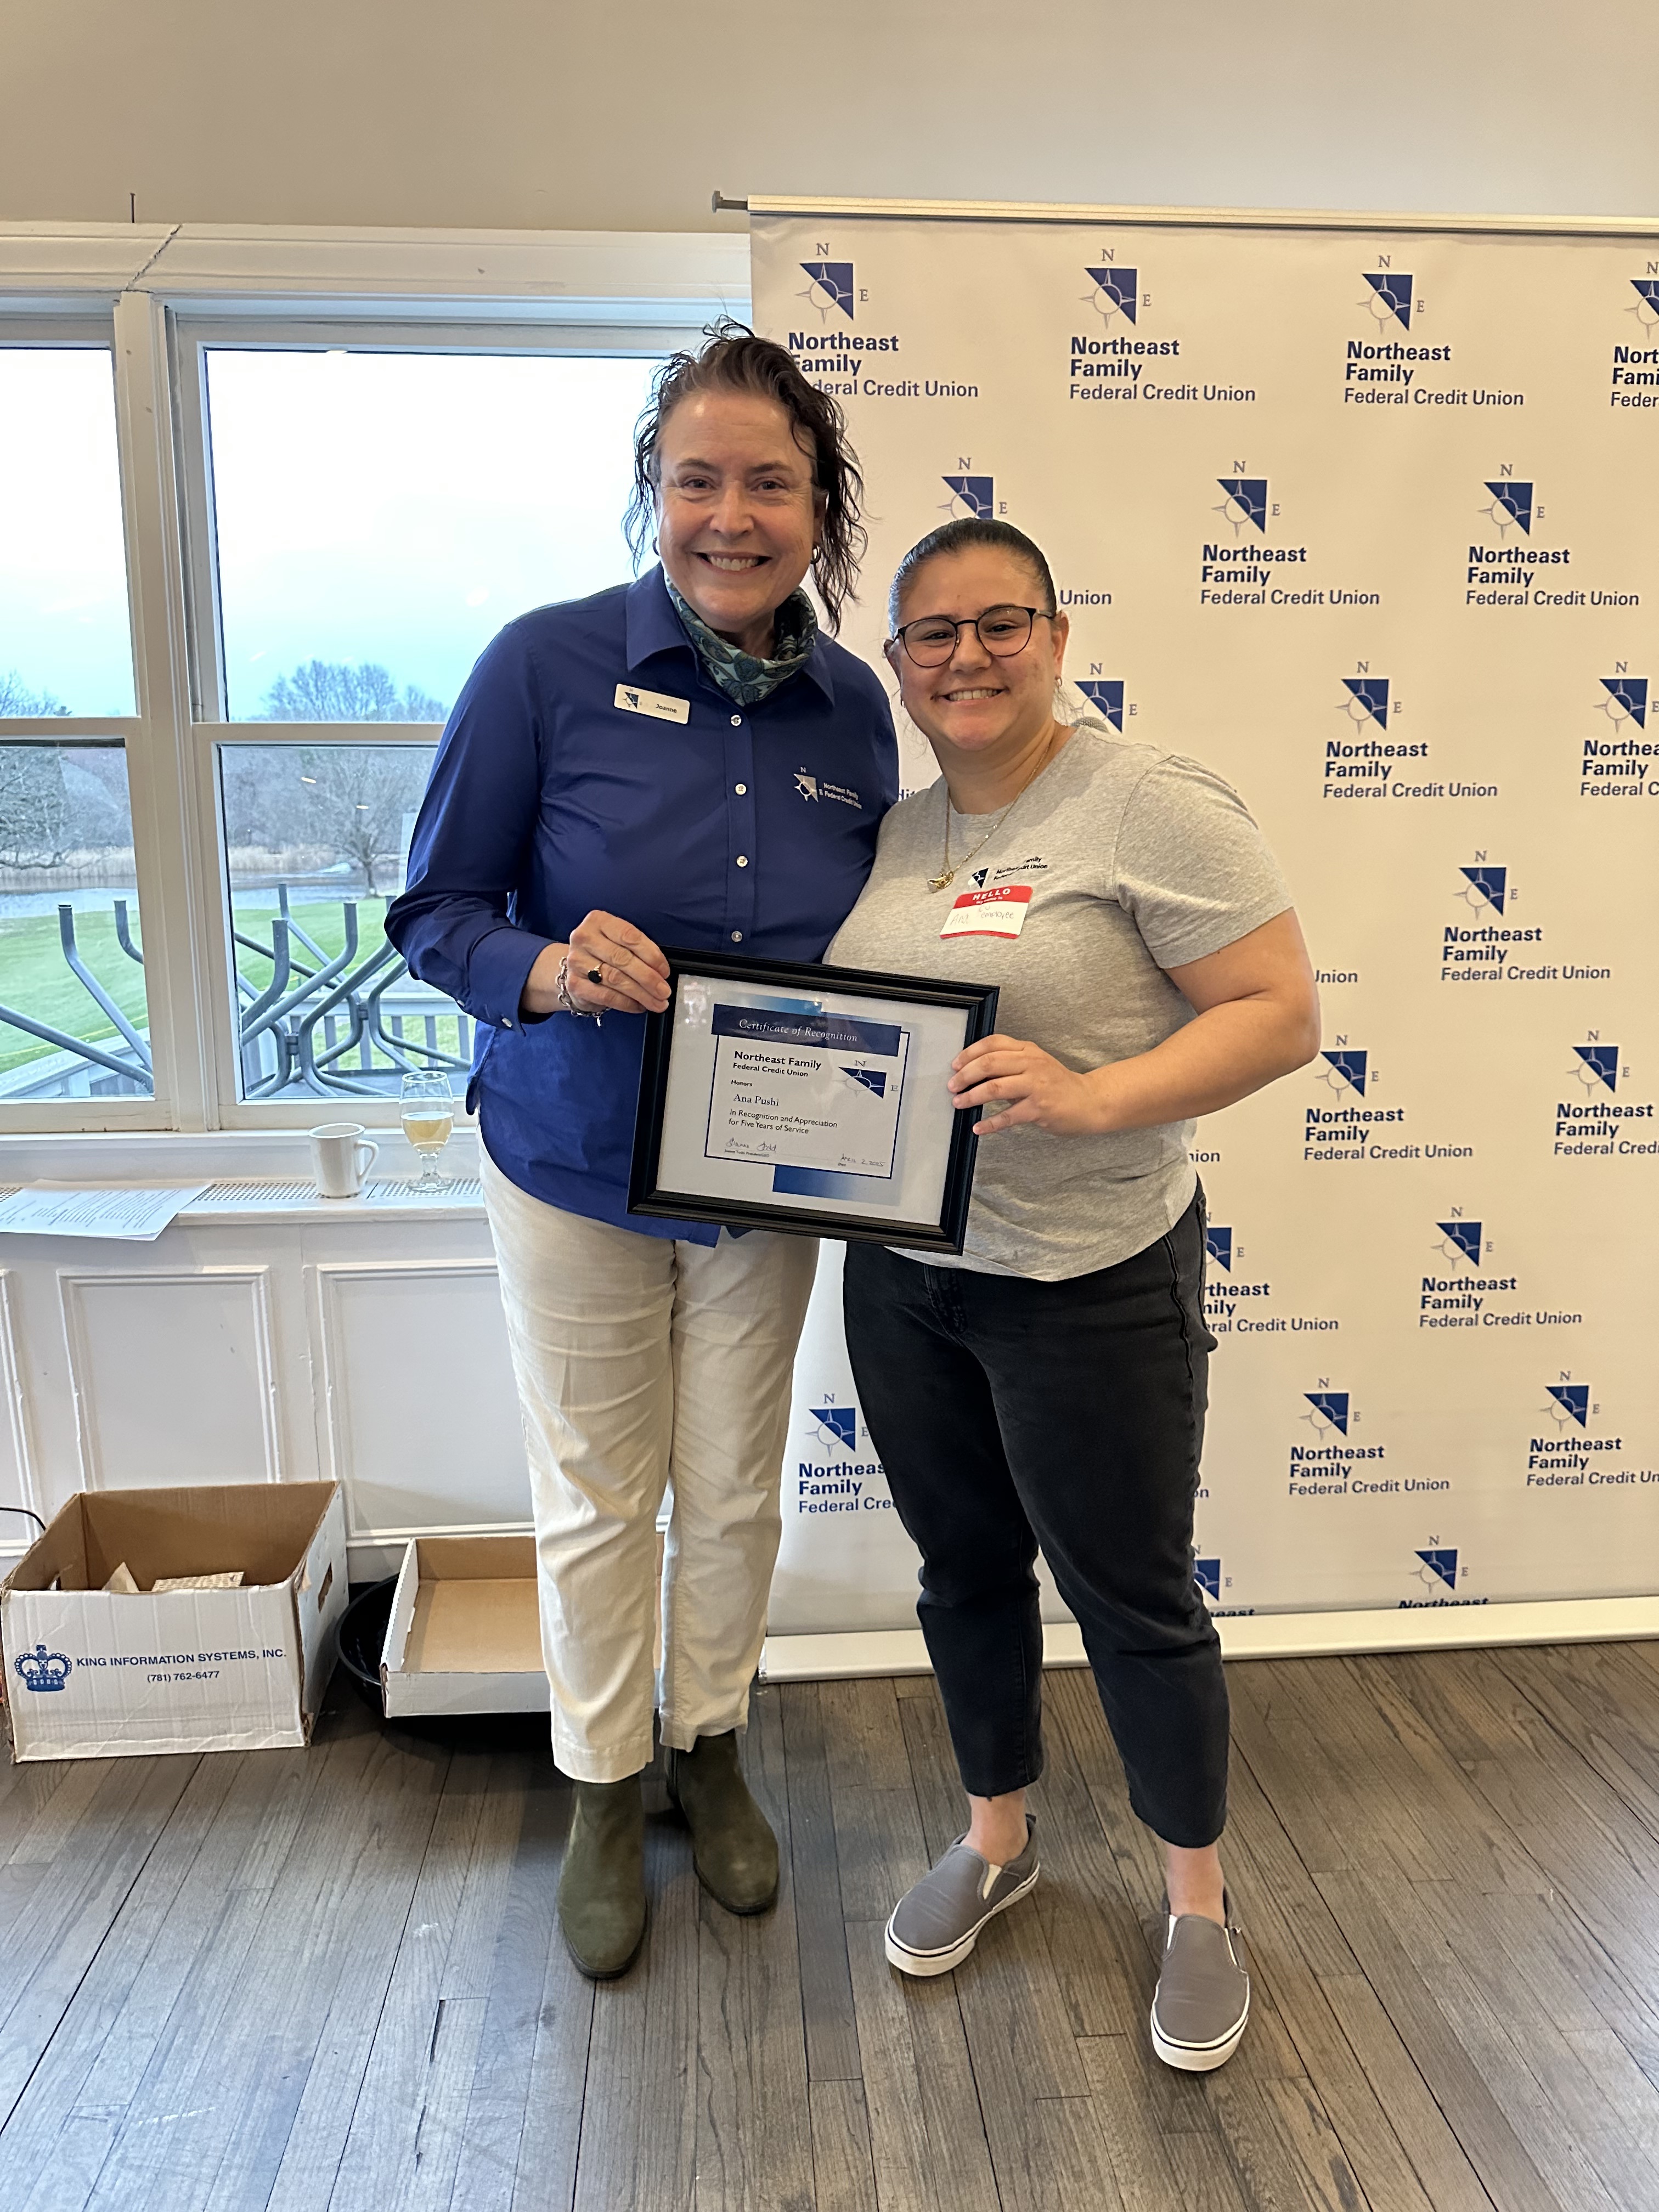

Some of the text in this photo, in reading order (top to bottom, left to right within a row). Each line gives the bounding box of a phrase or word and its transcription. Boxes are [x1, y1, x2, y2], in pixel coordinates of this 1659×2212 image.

[816, 243, 830, 256] N
[1102, 249, 1114, 261] N
[1378, 256, 1391, 268] N
[859, 289, 868, 301] E
[1143, 294, 1152, 306] E
[1417, 300, 1424, 313] E
[788, 332, 899, 352] Northeast
[1071, 337, 1180, 355] Northeast
[1347, 341, 1451, 360] Northeast
[1071, 359, 1142, 381] Family
[1346, 363, 1414, 386] Family
[812, 379, 978, 397] deral Credit Union
[1070, 384, 1255, 401] Federal Credit Union
[1345, 388, 1523, 405] Federal Credit Union
[1611, 392, 1659, 407] Feder
[958, 458, 972, 470] N
[1233, 461, 1246, 473] N
[1500, 464, 1513, 476] N
[999, 502, 1008, 514] E
[1271, 504, 1280, 516] E
[1537, 506, 1545, 518] E
[1203, 545, 1306, 562] Northeast
[1469, 546, 1570, 563] Northeast
[1202, 566, 1271, 586] Family
[1468, 567, 1534, 588] Family
[1060, 590, 1111, 605] Union
[1201, 590, 1379, 605] Federal Credit Union
[1466, 590, 1639, 605] Federal Credit Union
[1090, 663, 1103, 675] N
[1357, 662, 1369, 673] N
[1616, 662, 1628, 673] N
[656, 703, 677, 713] Joanne
[1129, 704, 1137, 715] E
[1393, 702, 1402, 713] E
[1327, 741, 1427, 757] Northeast
[1325, 761, 1392, 780] Family
[1582, 760, 1649, 779] Family
[1324, 783, 1497, 798] Federal Credit Union
[1581, 782, 1643, 795] Federal
[1475, 850, 1487, 862] N
[972, 888, 1011, 900] HELLO
[1510, 889, 1518, 900] E
[1444, 927, 1542, 942] Northeast
[1443, 945, 1508, 964] Family
[1441, 966, 1610, 980] Federal Credit Union
[739, 1019, 857, 1042] Certificate of Recognition
[1588, 1030, 1599, 1041] N
[1336, 1035, 1347, 1046] N
[734, 1051, 822, 1070] Northeast Family
[733, 1063, 760, 1071] Federal
[762, 1066, 785, 1075] Credit
[1622, 1066, 1630, 1077] E
[1372, 1071, 1379, 1082] E
[733, 1094, 779, 1106] Ana Pushi
[1306, 1108, 1404, 1123] Northeast
[1557, 1103, 1653, 1118] Northeast
[738, 1110, 778, 1121] Recognition
[794, 1117, 838, 1128] Appreciation
[755, 1121, 773, 1130] Years
[785, 1125, 809, 1134] Service
[1306, 1126, 1369, 1143] Family
[1556, 1121, 1619, 1138] Family
[1305, 1144, 1472, 1160] Federal Credit Union
[1554, 1142, 1614, 1155] Federal
[1451, 1207, 1463, 1217] N
[1237, 1247, 1244, 1257] E
[1486, 1242, 1493, 1252] E
[1205, 1282, 1270, 1296] theast
[1422, 1277, 1516, 1291] Northeast
[1421, 1294, 1483, 1311] Family
[1237, 1319, 1286, 1331] Credit
[1291, 1318, 1338, 1330] Union
[1420, 1312, 1582, 1327] Federal Credit Union
[1318, 1378, 1329, 1388] N
[1560, 1371, 1571, 1381] N
[824, 1393, 835, 1404] N
[1593, 1404, 1600, 1414] E
[1353, 1412, 1361, 1422] E
[1531, 1437, 1621, 1452] Northeast
[1291, 1446, 1384, 1460] Northeast
[1528, 1454, 1589, 1470] Family
[799, 1462, 886, 1478] Northeas
[1290, 1463, 1351, 1479] Family
[1527, 1472, 1584, 1486] Federal
[1589, 1471, 1635, 1484] Credit
[799, 1479, 862, 1496] Family
[1289, 1478, 1449, 1495] Federal Credit Union
[799, 1498, 858, 1513] Federal
[1429, 1535, 1440, 1545] N
[1461, 1567, 1468, 1577] E
[76, 1649, 287, 1667] KING INFORMATION SYSTEMS, INC.
[147, 1671, 220, 1683] (781) 762-6477
